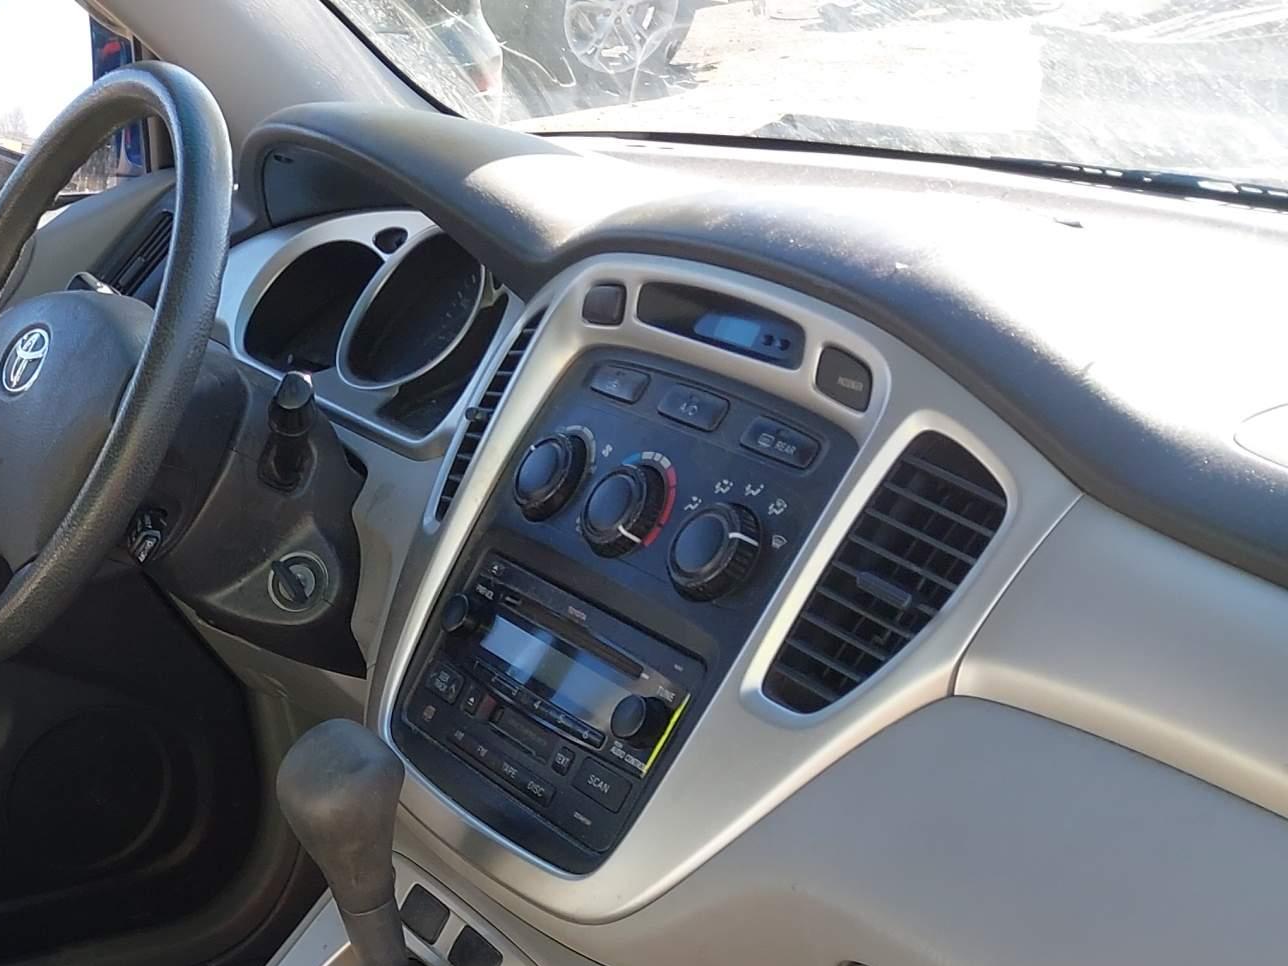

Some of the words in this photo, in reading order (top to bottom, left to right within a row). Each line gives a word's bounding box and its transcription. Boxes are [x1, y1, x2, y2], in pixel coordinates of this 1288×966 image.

[679, 402, 699, 416] A/C
[775, 440, 797, 456] REAR
[656, 685, 676, 702] TUNE
[502, 761, 519, 779] TAPE
[527, 780, 545, 797] DISC
[587, 774, 610, 794] SCAN
